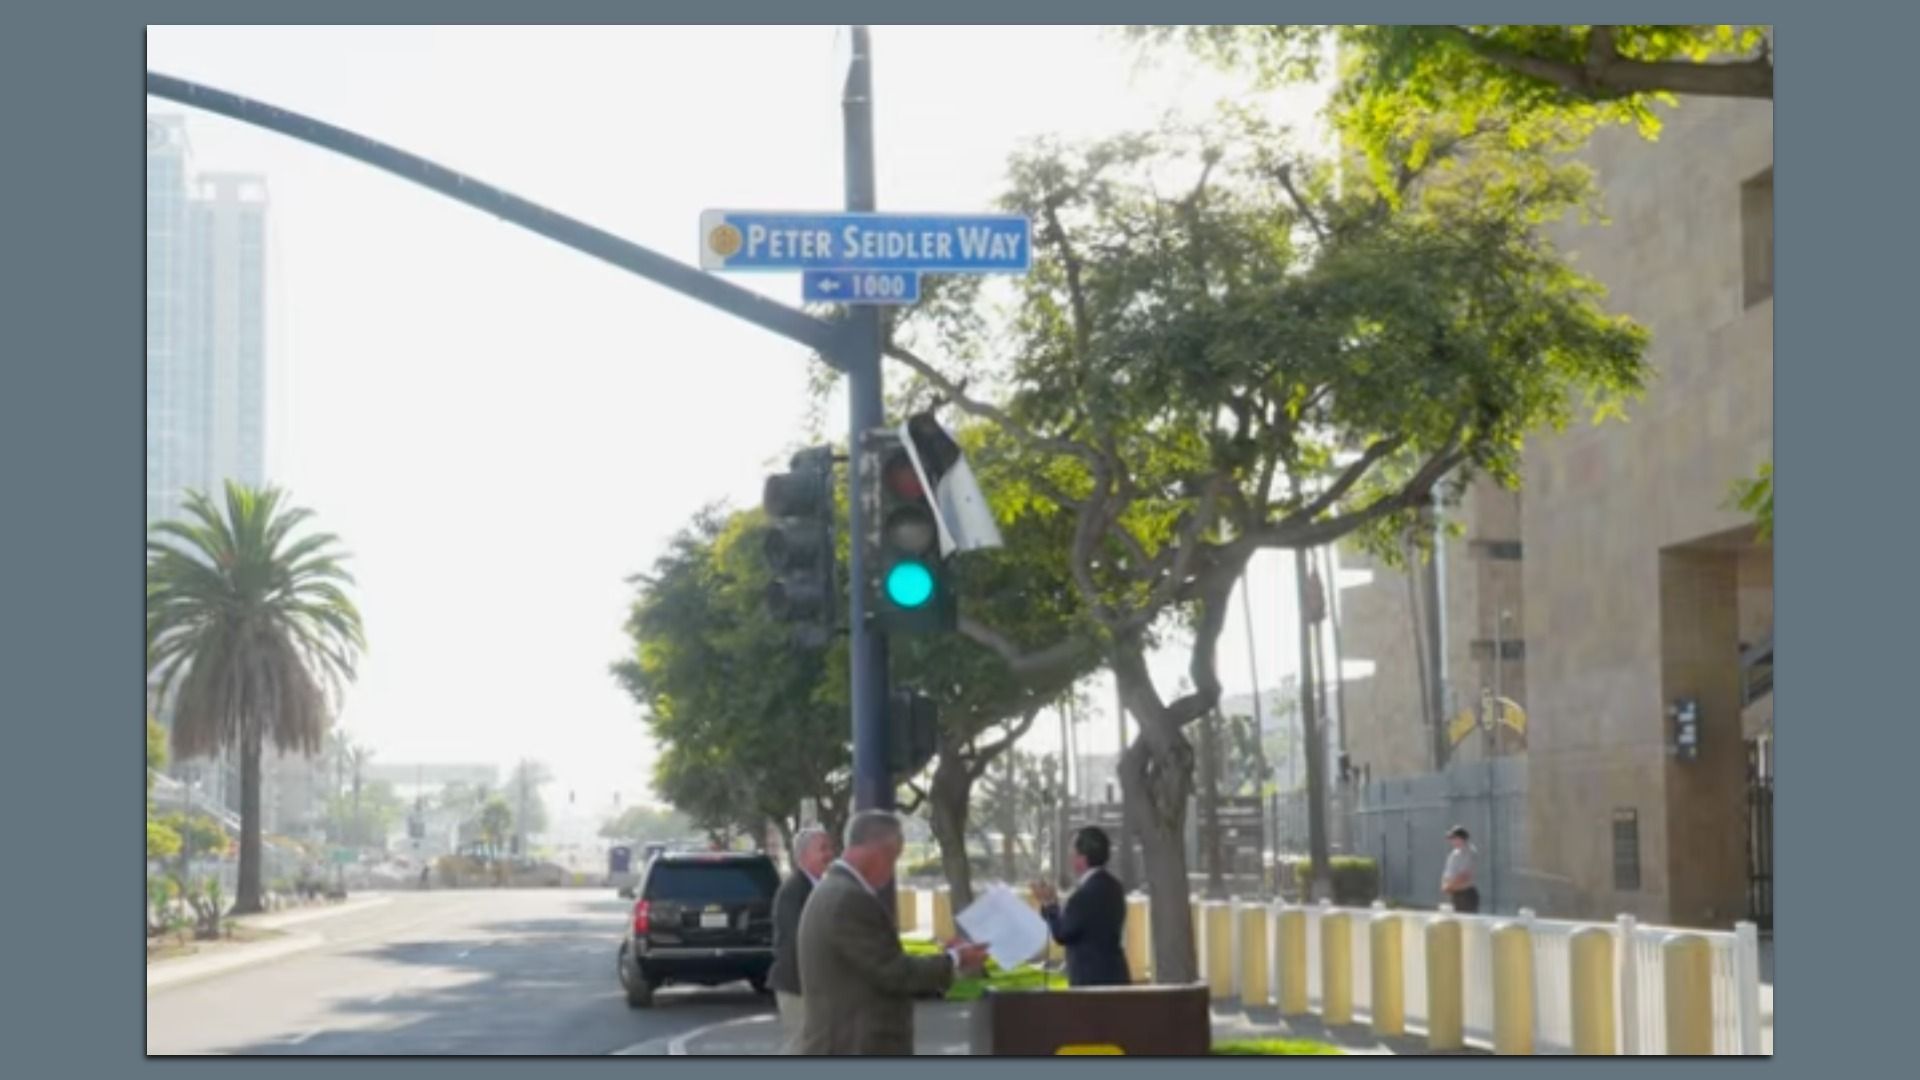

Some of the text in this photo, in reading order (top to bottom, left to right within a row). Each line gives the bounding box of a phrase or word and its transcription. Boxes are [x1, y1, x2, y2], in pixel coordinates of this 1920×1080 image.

[747, 224, 1021, 261] PETER SEIDLER WAY
[852, 275, 906, 297] 1000
